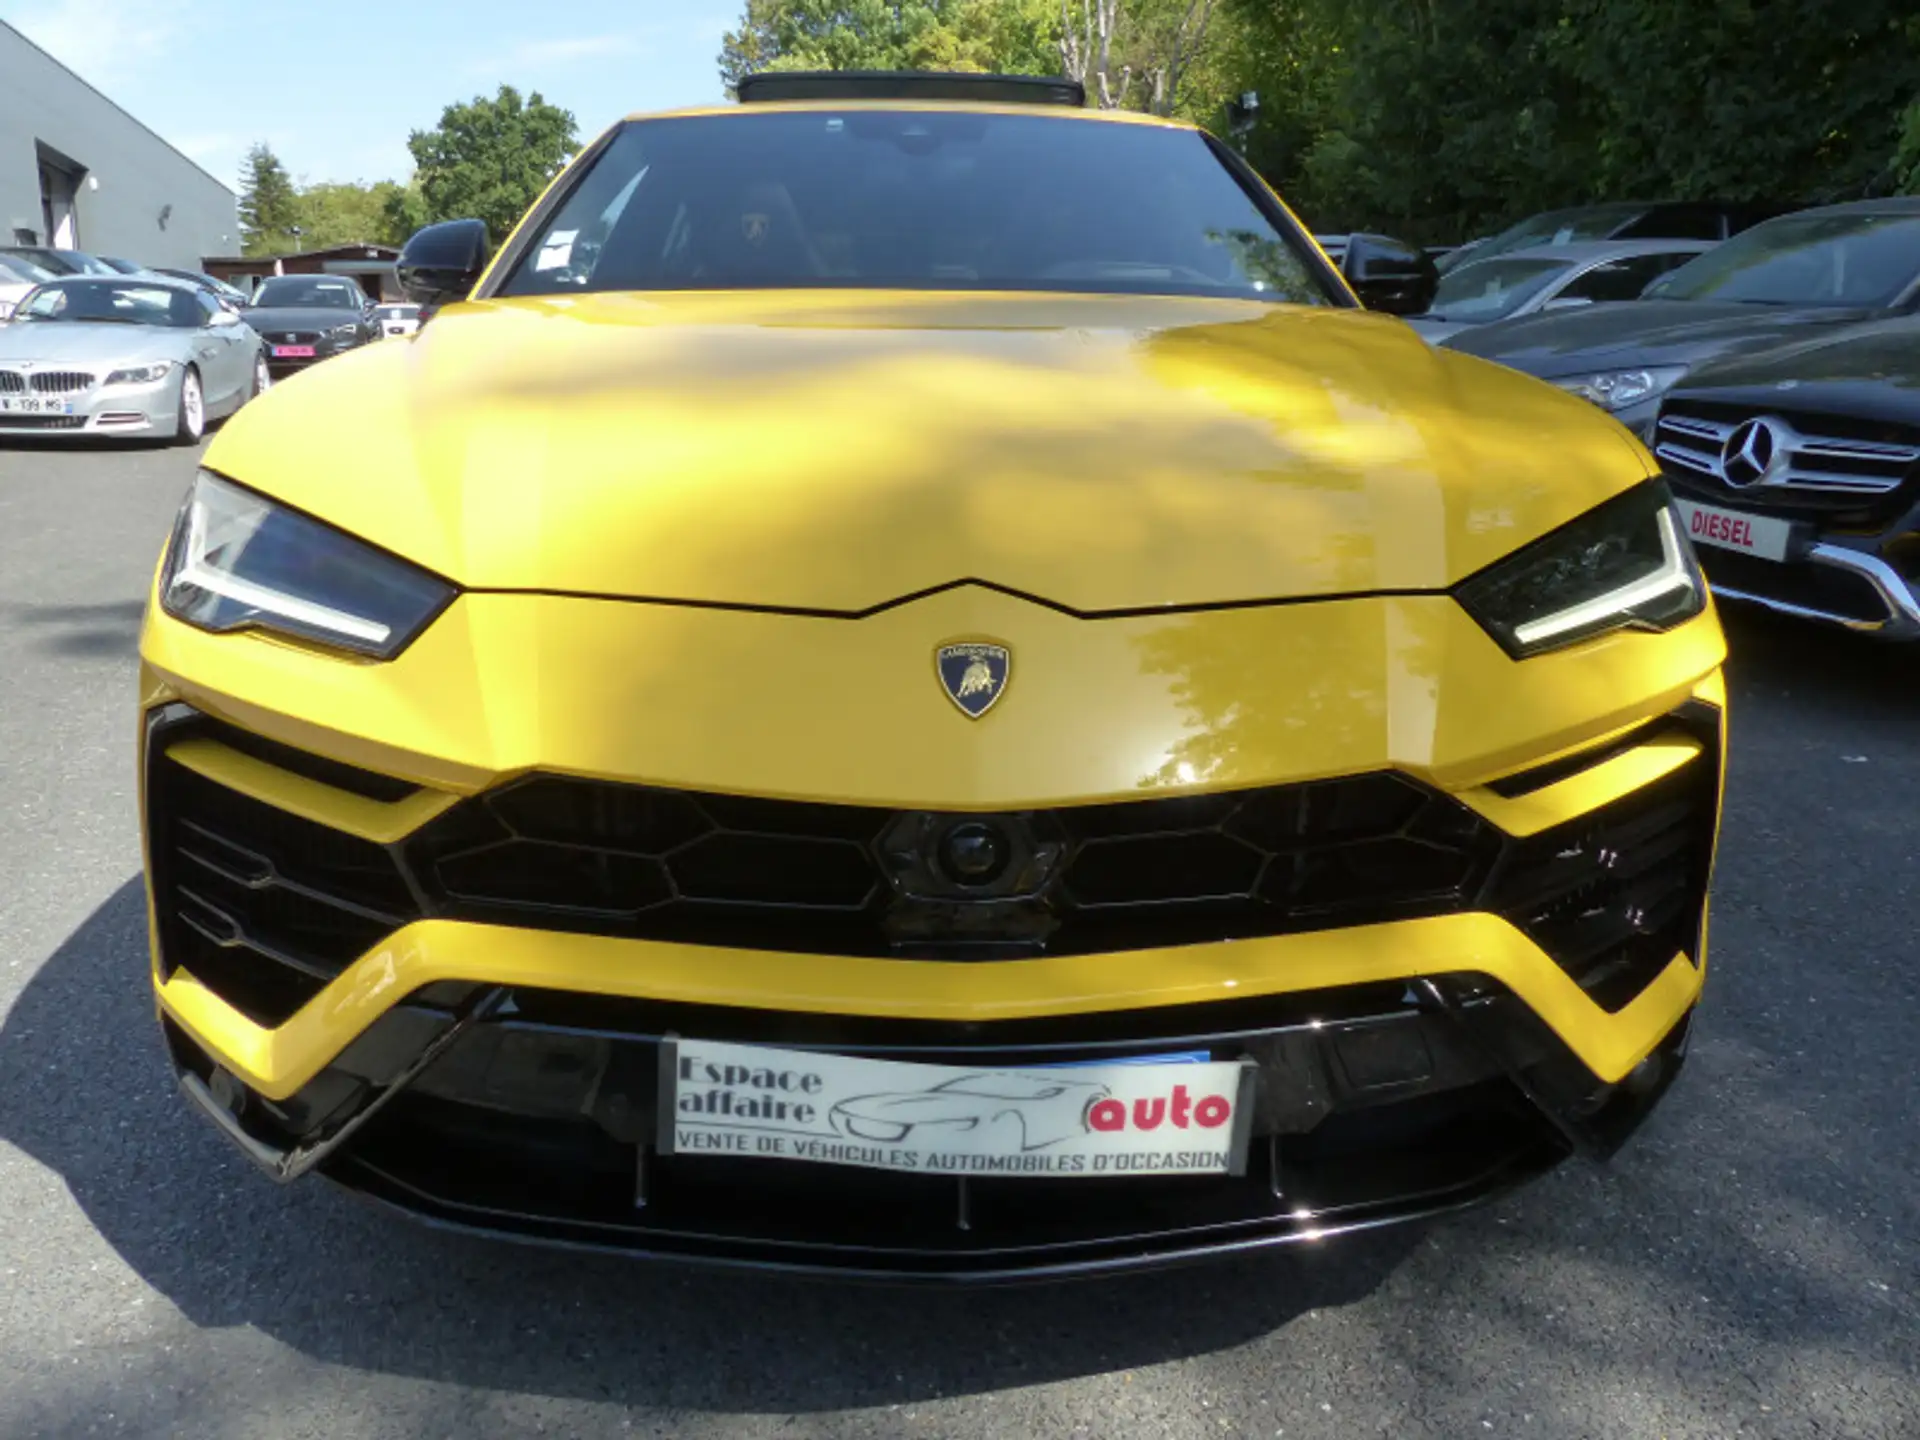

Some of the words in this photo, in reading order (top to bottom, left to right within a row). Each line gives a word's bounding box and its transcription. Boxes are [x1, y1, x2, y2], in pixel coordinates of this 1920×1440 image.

[1691, 510, 1753, 547] DIESEL
[679, 1056, 823, 1094] Espace
[678, 1089, 816, 1124] affaire
[1089, 1085, 1231, 1132] auto
[678, 1131, 750, 1150] VENTE
[757, 1136, 786, 1153] DE
[793, 1139, 919, 1168] VÉHICULES
[926, 1151, 1085, 1173] AUTOMOBILES
[1092, 1151, 1229, 1171] D'OCCASION
